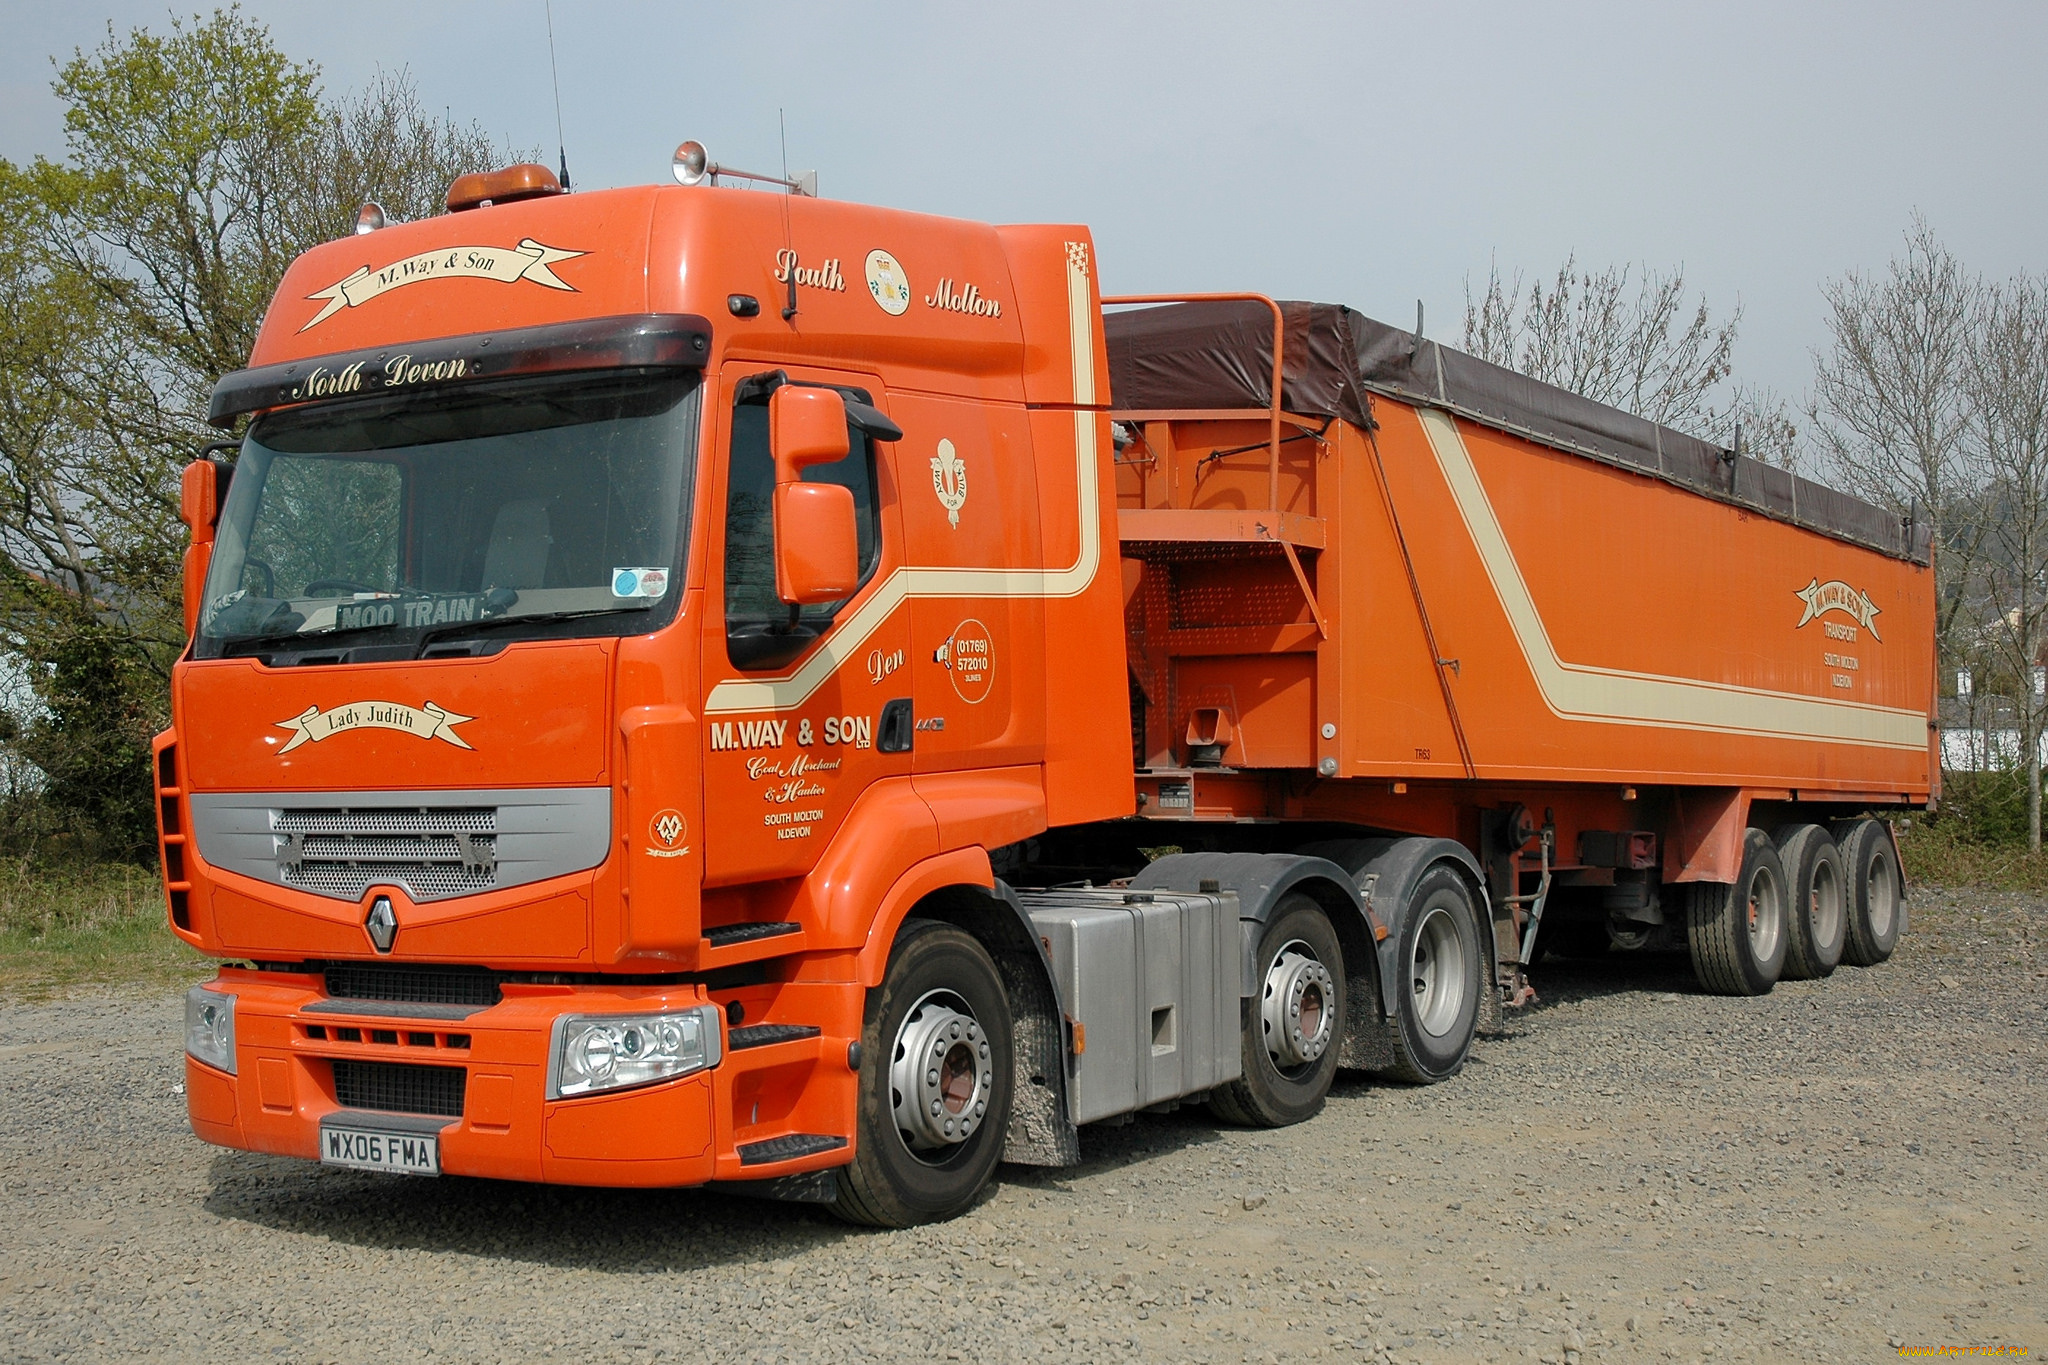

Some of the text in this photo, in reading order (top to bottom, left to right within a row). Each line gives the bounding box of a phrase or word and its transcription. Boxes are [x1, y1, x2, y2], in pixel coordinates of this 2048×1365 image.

[444, 252, 458, 269] &
[464, 251, 495, 271] Son
[925, 277, 1002, 317] Molton
[292, 354, 467, 399] North Devon
[934, 469, 943, 494] WAY
[342, 598, 475, 628] MOO TRAIN
[1823, 620, 1857, 643] TRANSPORT
[957, 639, 988, 656] (01769)
[867, 648, 905, 685] Den
[957, 657, 988, 671] 572010
[328, 706, 413, 730] Lady Judith
[711, 715, 871, 750] M.WAY & SON
[856, 740, 871, 749] LTD
[746, 754, 841, 780] Coal Merchant
[764, 779, 825, 803] & Haulier
[764, 809, 824, 826] SOUTH MOLTON
[328, 1132, 430, 1167] WX06 FMA
